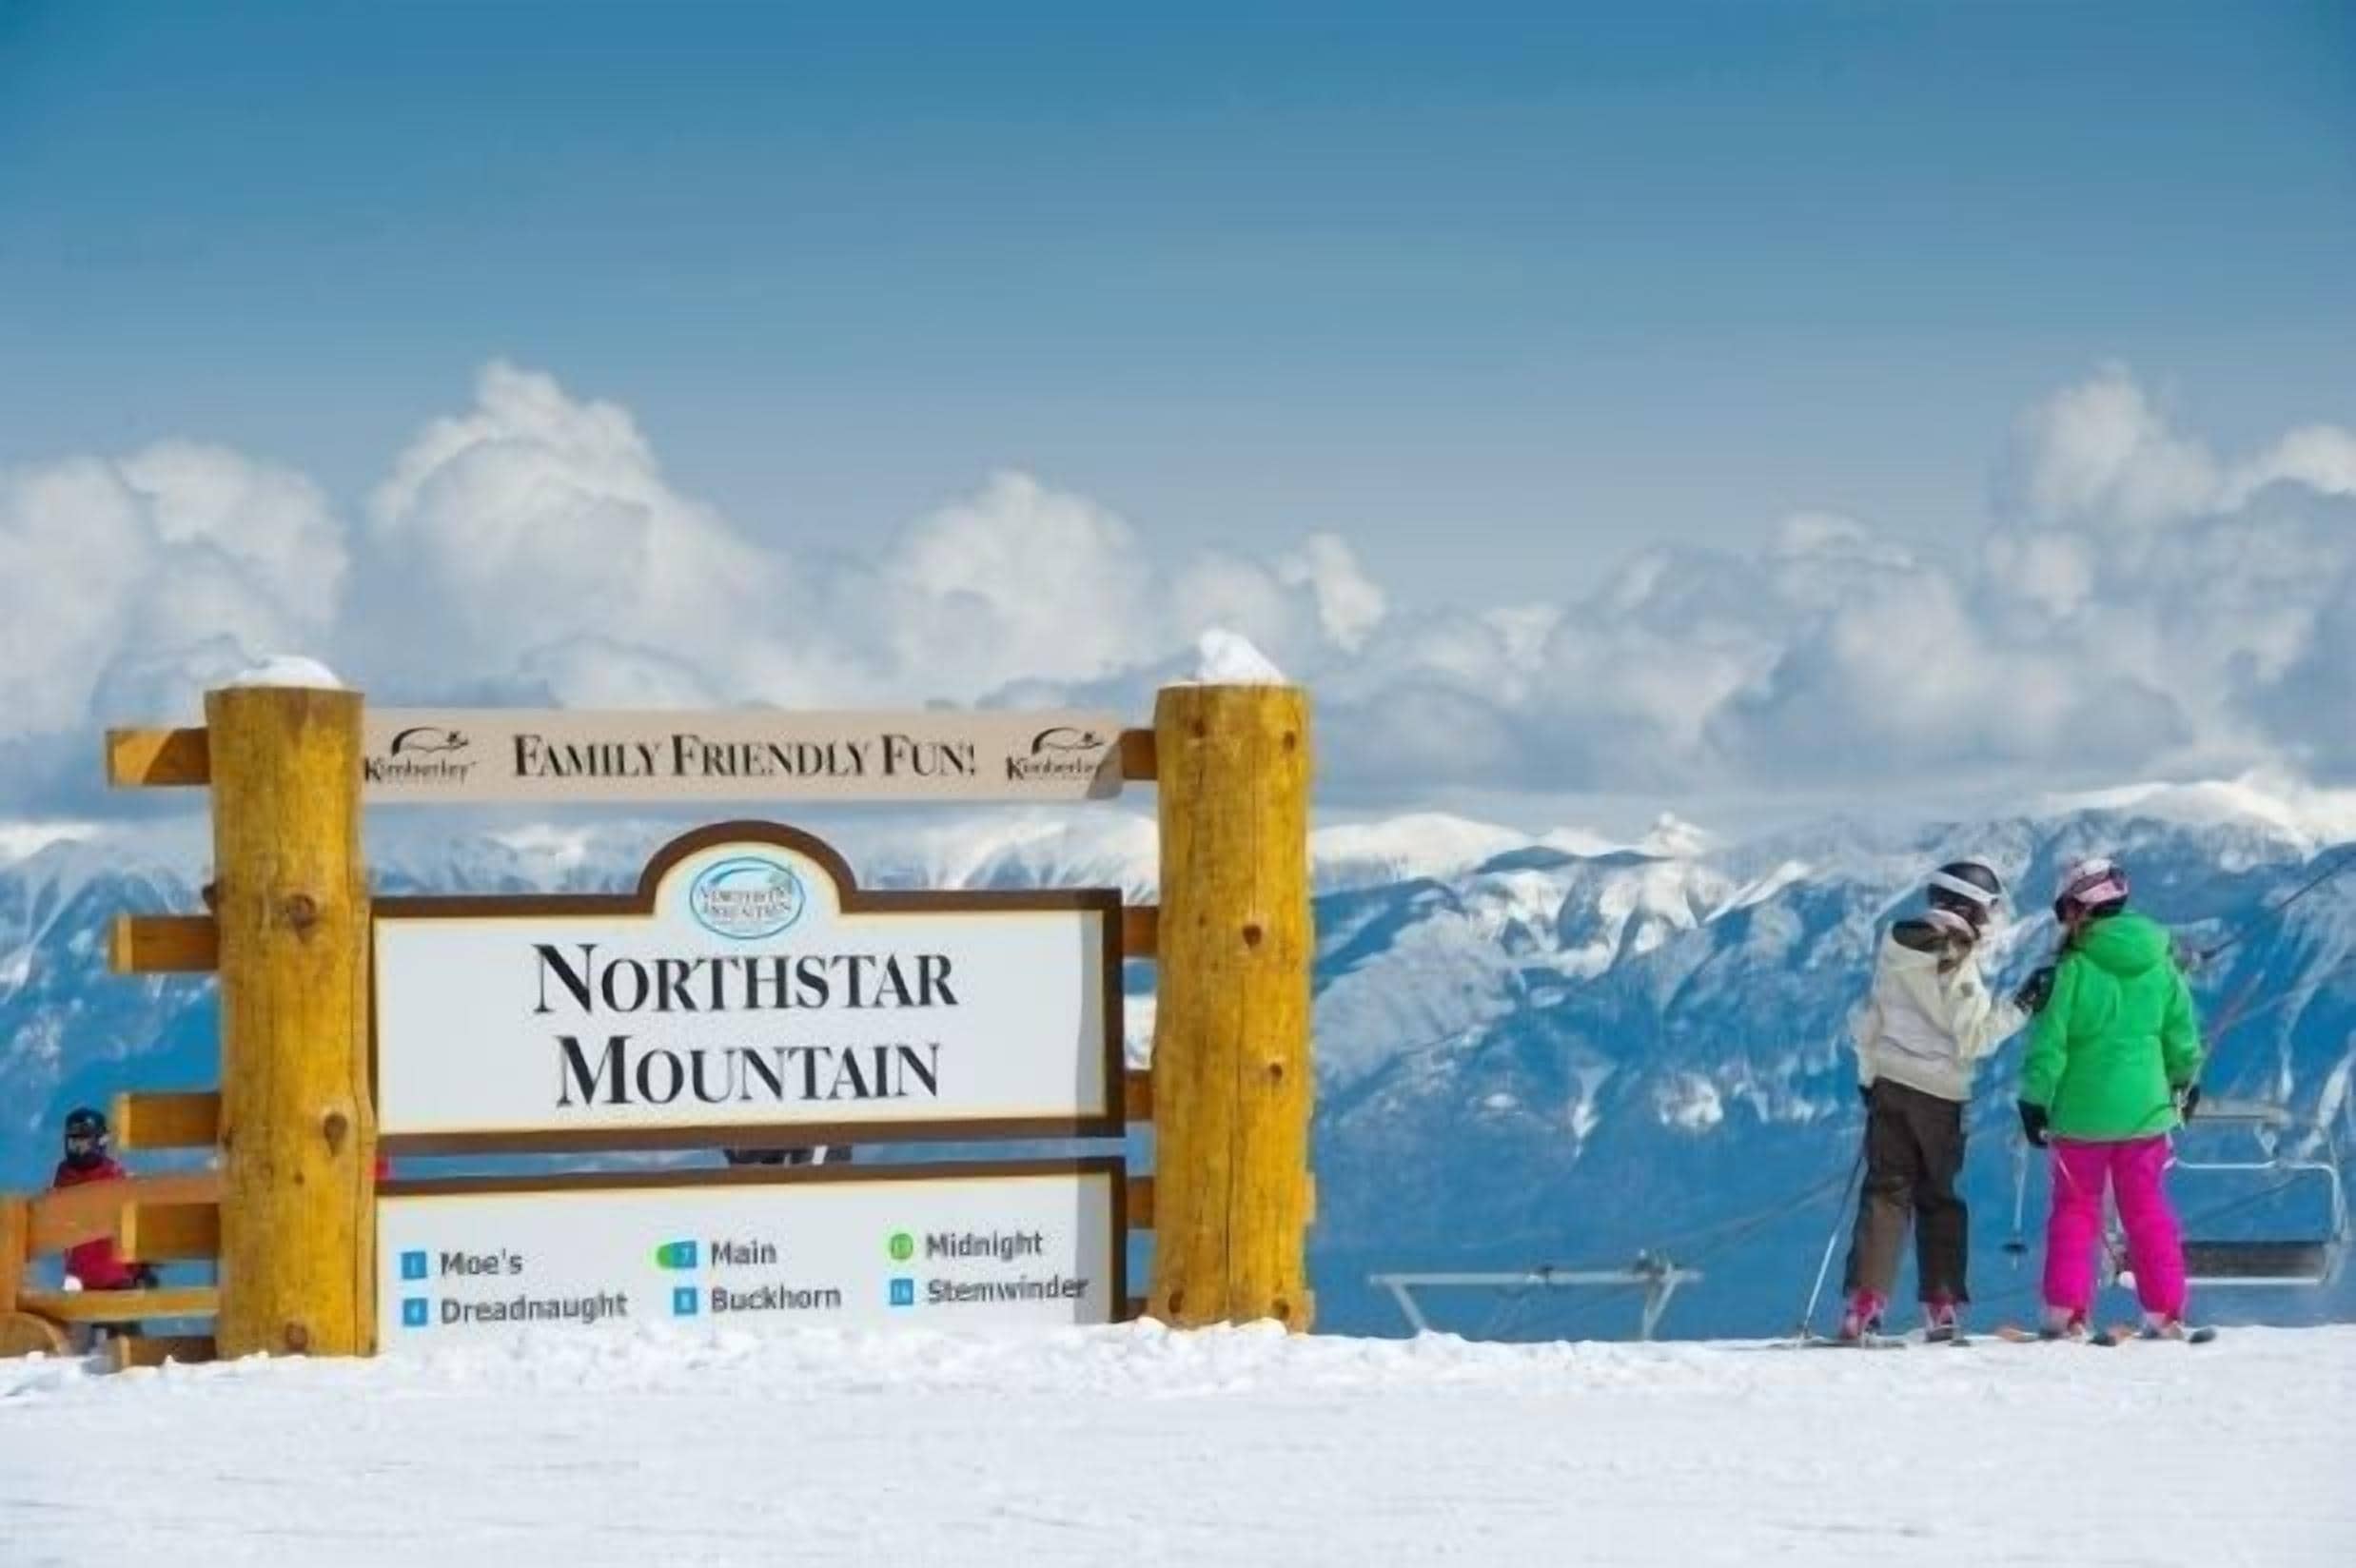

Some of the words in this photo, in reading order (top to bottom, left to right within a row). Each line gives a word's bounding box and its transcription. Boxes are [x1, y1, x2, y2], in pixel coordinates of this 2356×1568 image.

[515, 734, 660, 777] FAMILY
[672, 734, 869, 777] FRIENDLY
[881, 734, 975, 776] FUN!
[533, 943, 959, 1014] NORTHSTAR
[555, 1034, 941, 1107] MOUNTAIN
[441, 1248, 524, 1277] Moe's
[712, 1241, 778, 1266] Main
[926, 1230, 1043, 1263] Midnight
[712, 1284, 842, 1312] Buckhorn
[929, 1274, 1088, 1304] Stemwinder
[442, 1291, 629, 1326] Dreadnaught
